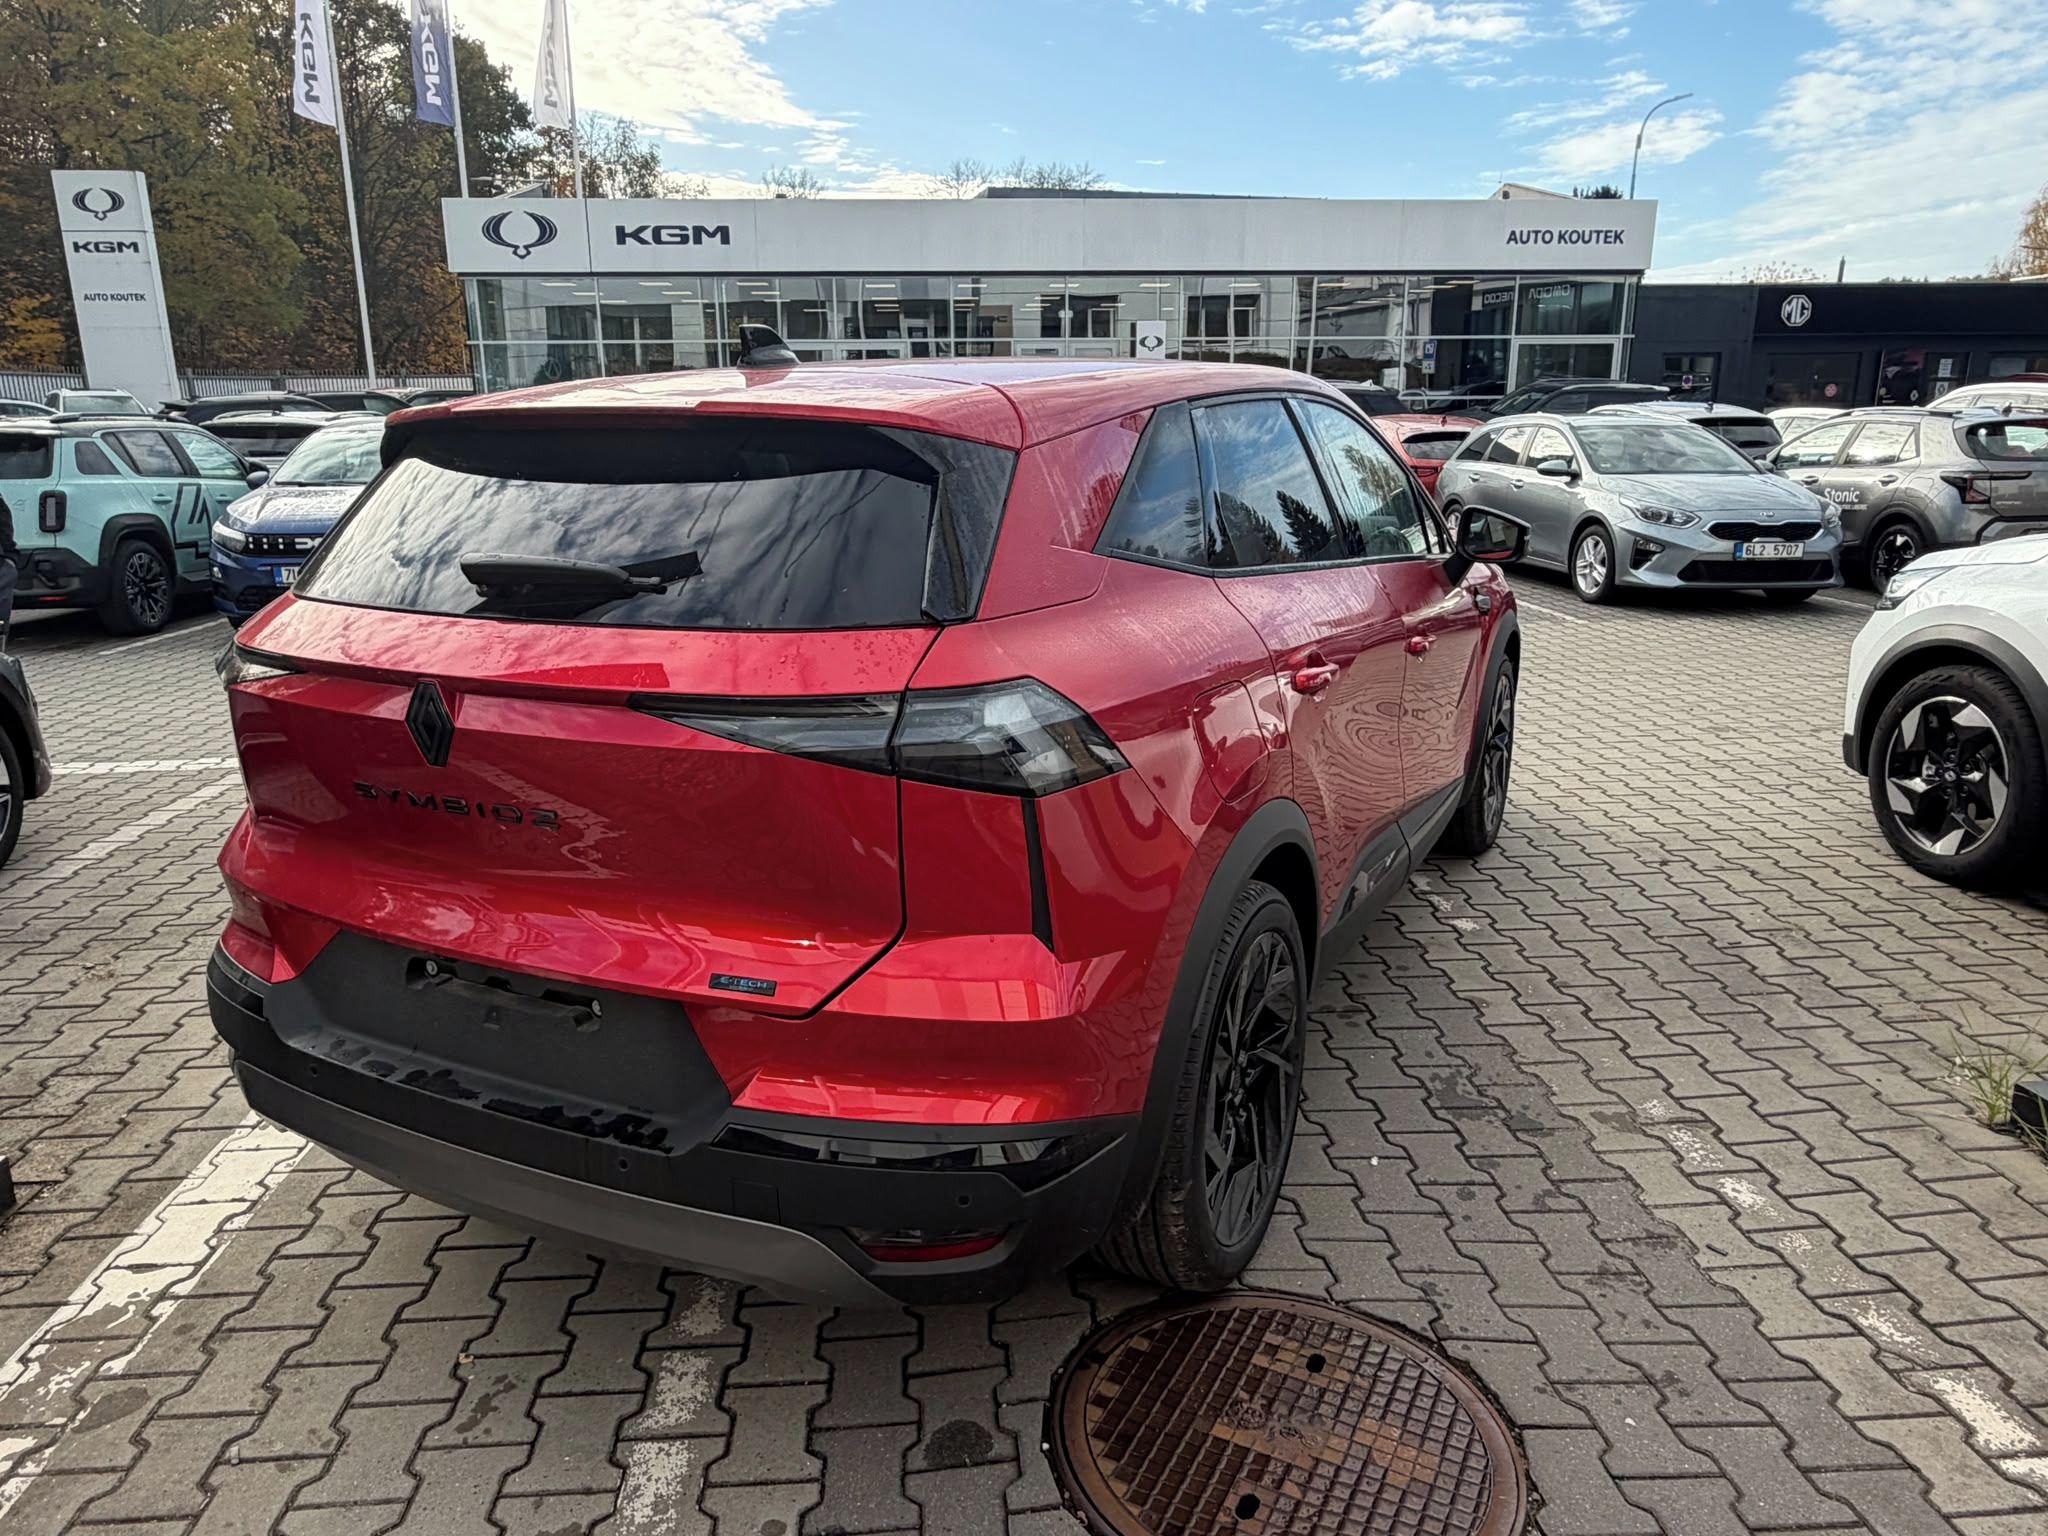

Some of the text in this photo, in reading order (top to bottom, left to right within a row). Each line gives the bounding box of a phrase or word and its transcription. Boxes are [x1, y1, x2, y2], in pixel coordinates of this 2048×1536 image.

[300, 13, 320, 104] KGM
[420, 14, 442, 107] KGM
[615, 225, 731, 246] KGM
[1506, 229, 1625, 245] AUTO KOUTEK
[72, 241, 140, 254] KGM
[84, 293, 147, 302] AUTO KOUTEK
[1783, 296, 1811, 325] MG
[1824, 487, 1861, 503] Stonic
[1745, 544, 1799, 556] 6L2 5707
[353, 780, 561, 831] SYMBIOZ
